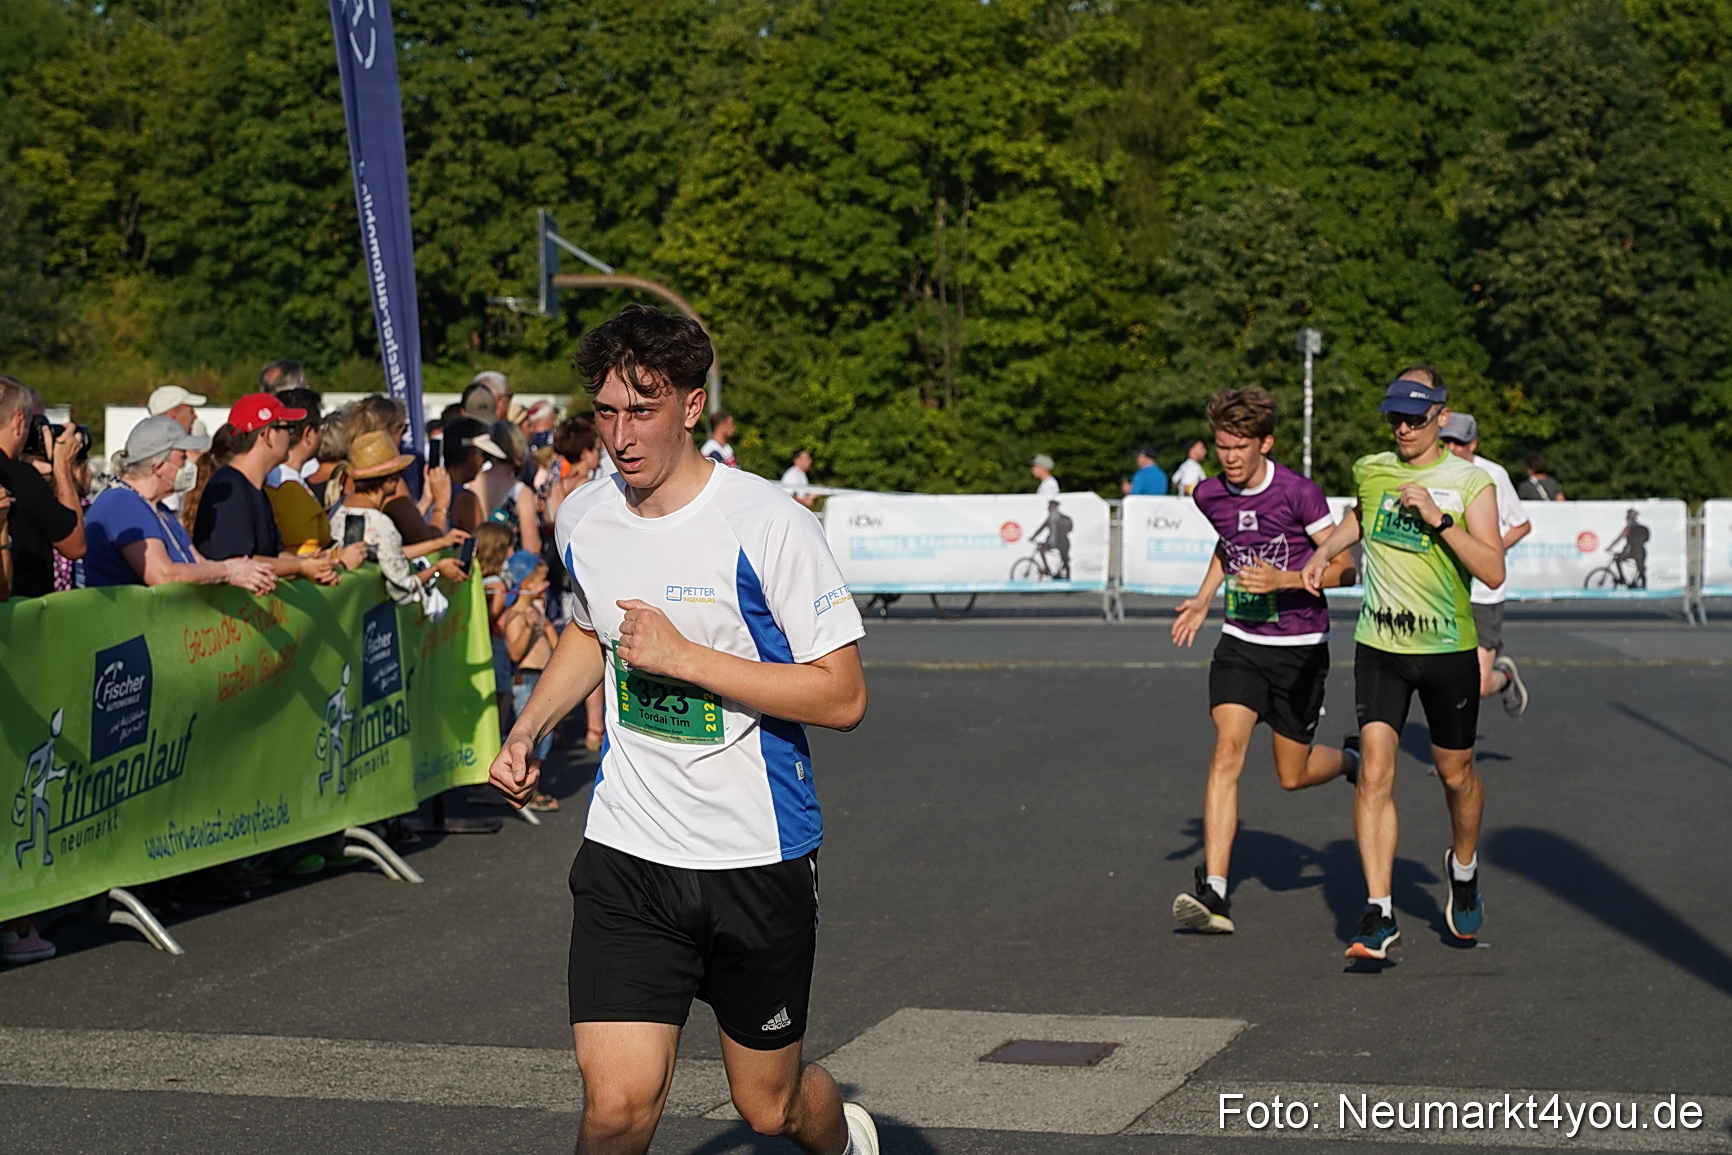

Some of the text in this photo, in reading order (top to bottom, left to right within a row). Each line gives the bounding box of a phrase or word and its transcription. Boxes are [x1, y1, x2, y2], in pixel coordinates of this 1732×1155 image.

[683, 586, 716, 597] PETTER
[103, 674, 146, 703] Fischer
[620, 681, 630, 712] RUN
[636, 677, 689, 715] 323
[639, 709, 691, 728] Tordai Tim
[703, 692, 717, 732] 2022
[61, 712, 198, 826] firmenlauf
[60, 814, 119, 854] neumarkt
[761, 1018, 791, 1032] adidas
